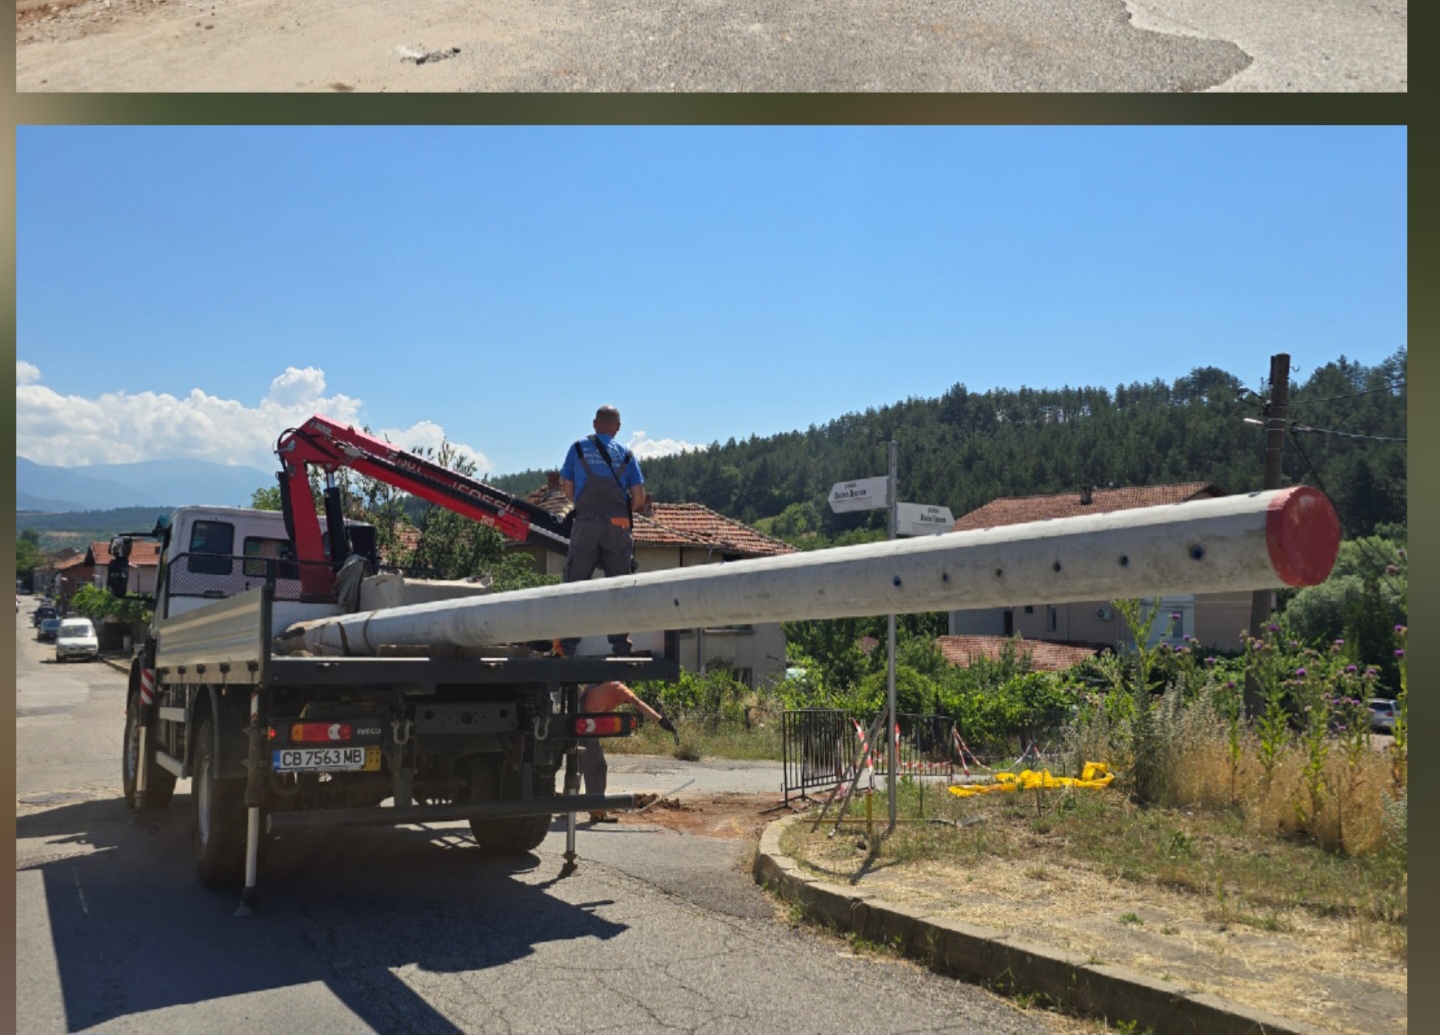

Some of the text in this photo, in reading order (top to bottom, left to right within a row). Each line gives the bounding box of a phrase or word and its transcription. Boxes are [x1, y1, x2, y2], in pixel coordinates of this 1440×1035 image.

[282, 749, 362, 766] CB 7563 MB
